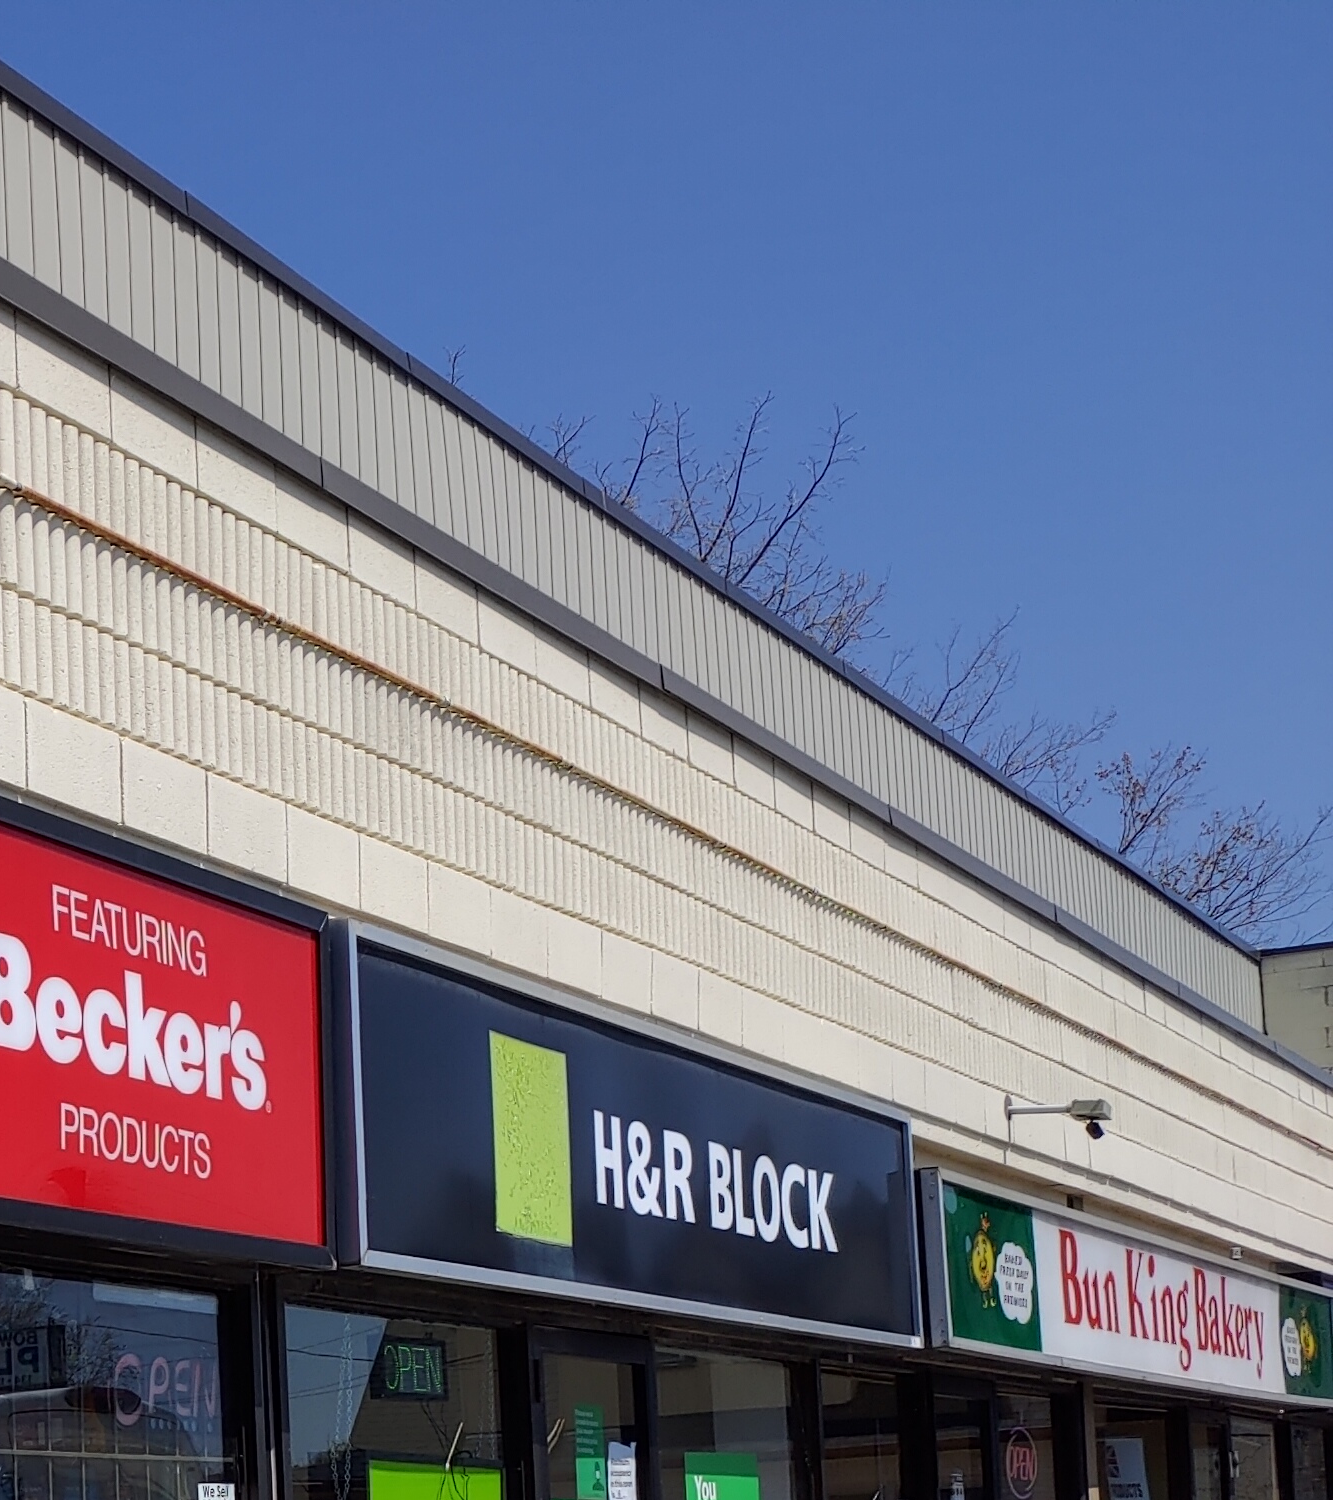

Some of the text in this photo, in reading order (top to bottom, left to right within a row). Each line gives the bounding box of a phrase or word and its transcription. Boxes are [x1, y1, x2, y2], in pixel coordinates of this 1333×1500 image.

[51, 884, 207, 978] FEATURING
[60, 1101, 212, 1180] PRODUCTS
[592, 1109, 840, 1253] H&R BLOCK
[1058, 1228, 1120, 1335] Bun
[1126, 1247, 1192, 1371] King
[1193, 1266, 1265, 1379] Bakery
[384, 1345, 443, 1394] OPEN
[694, 1475, 717, 1500] You
[1009, 1445, 1035, 1481] OPEN
